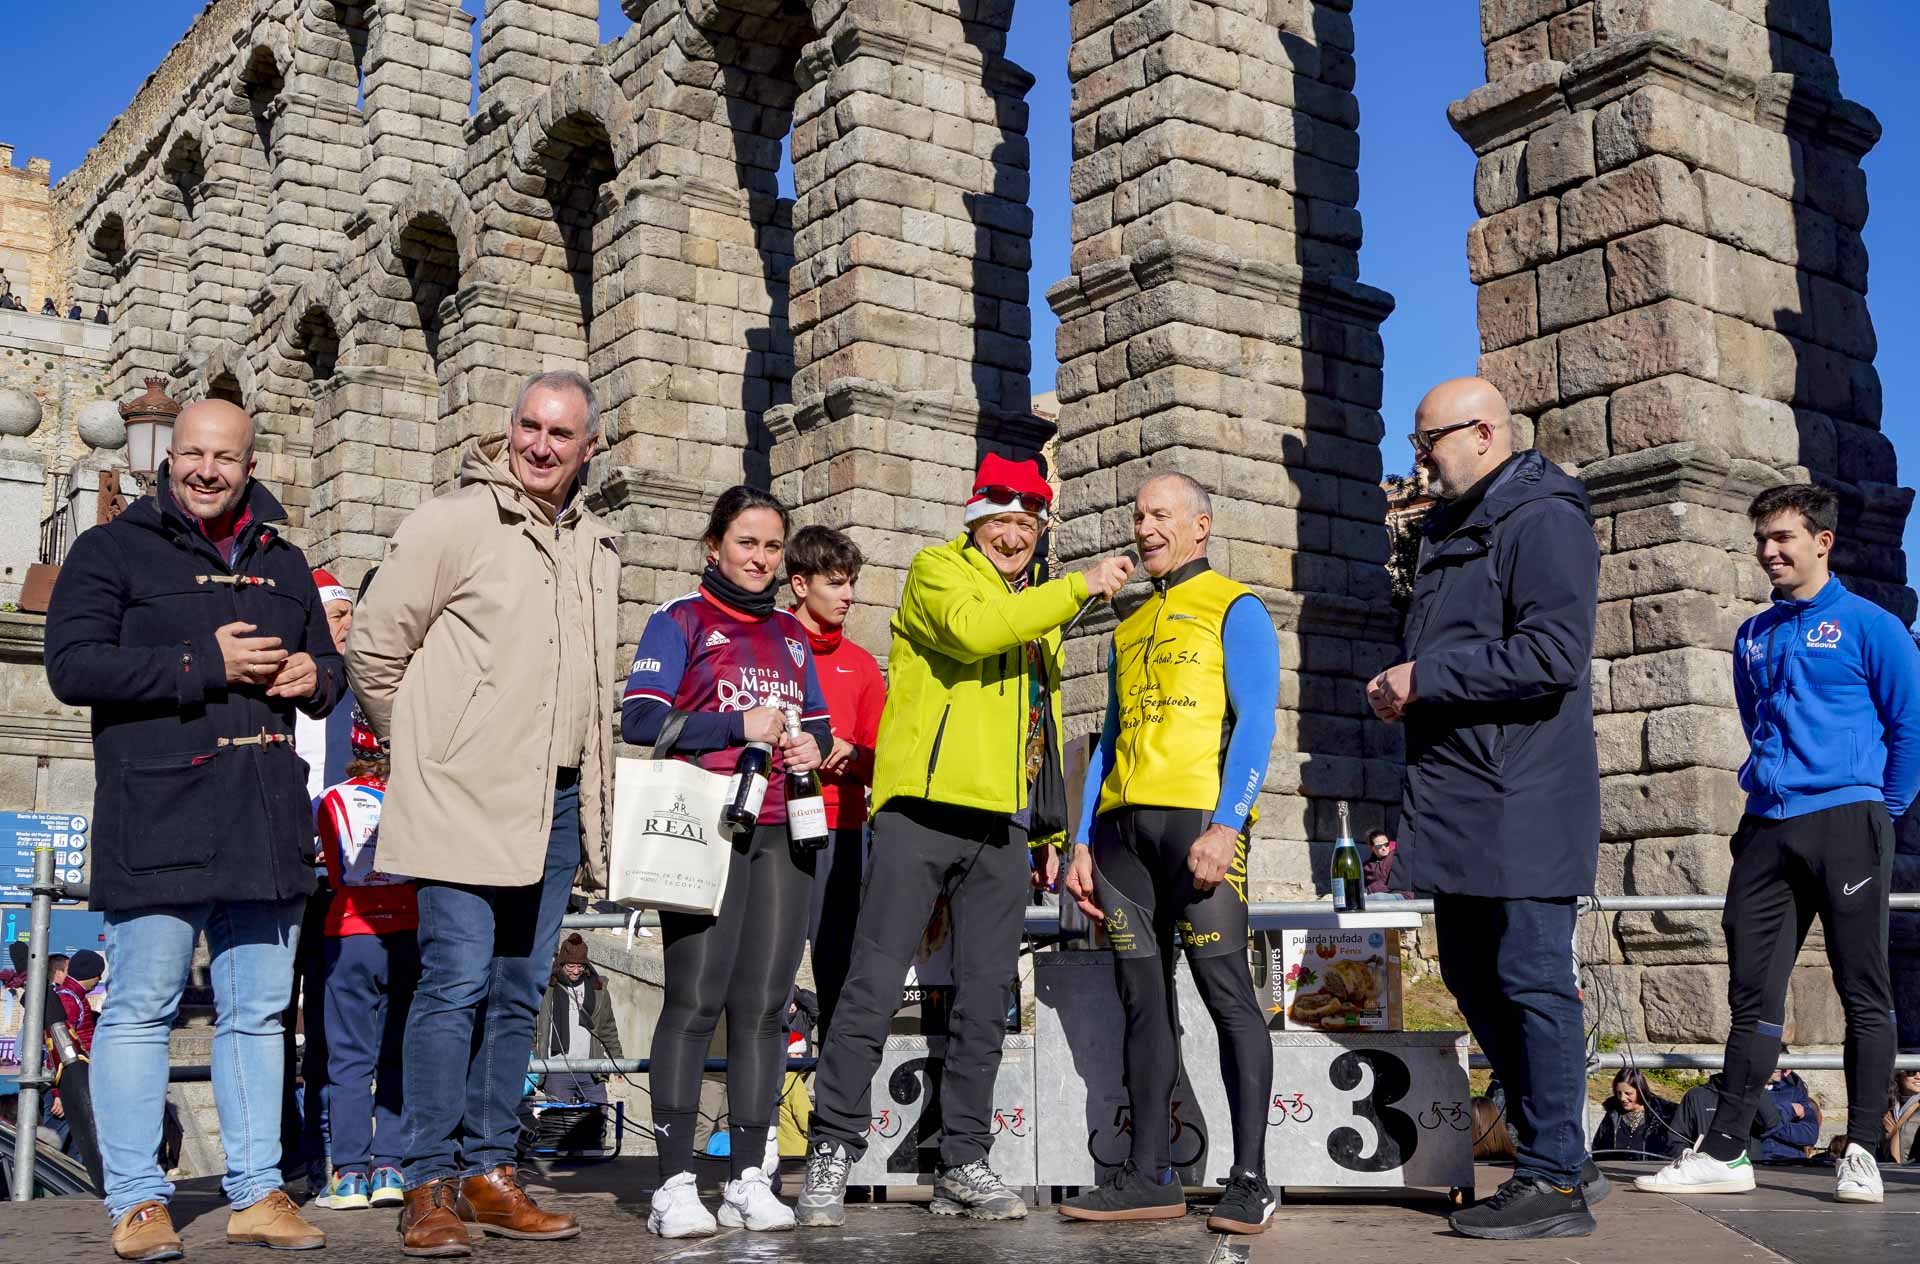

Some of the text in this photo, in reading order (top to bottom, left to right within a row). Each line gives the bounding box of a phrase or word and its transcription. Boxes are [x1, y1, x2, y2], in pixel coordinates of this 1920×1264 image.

[706, 637, 731, 647] adidas
[739, 667, 779, 679] venta
[741, 675, 804, 702] Magullo
[1292, 931, 1363, 946] pularda trufada
[1271, 948, 1285, 1002] cascajares
[1327, 1048, 1418, 1173] 3
